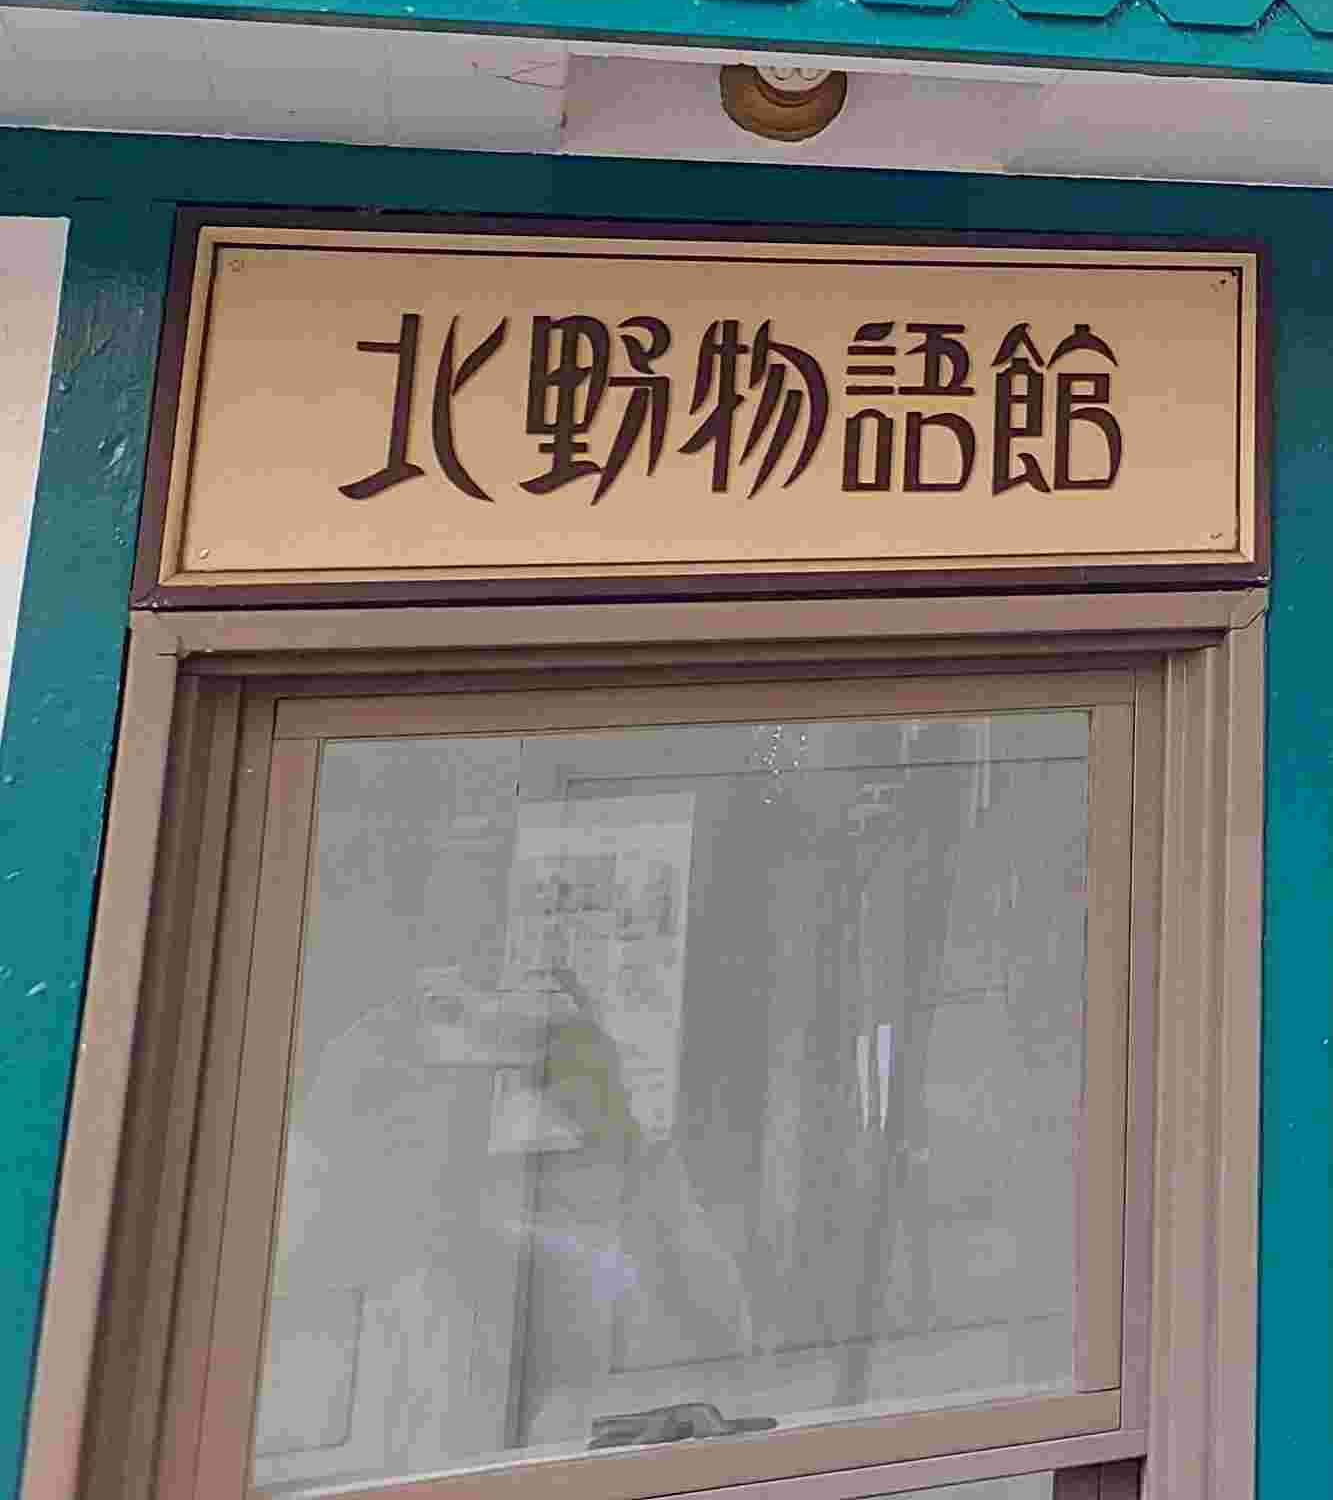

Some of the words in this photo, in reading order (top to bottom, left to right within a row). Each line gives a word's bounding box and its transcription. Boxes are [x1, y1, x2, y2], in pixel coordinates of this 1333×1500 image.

[337, 312, 1123, 505] 北野物語館
